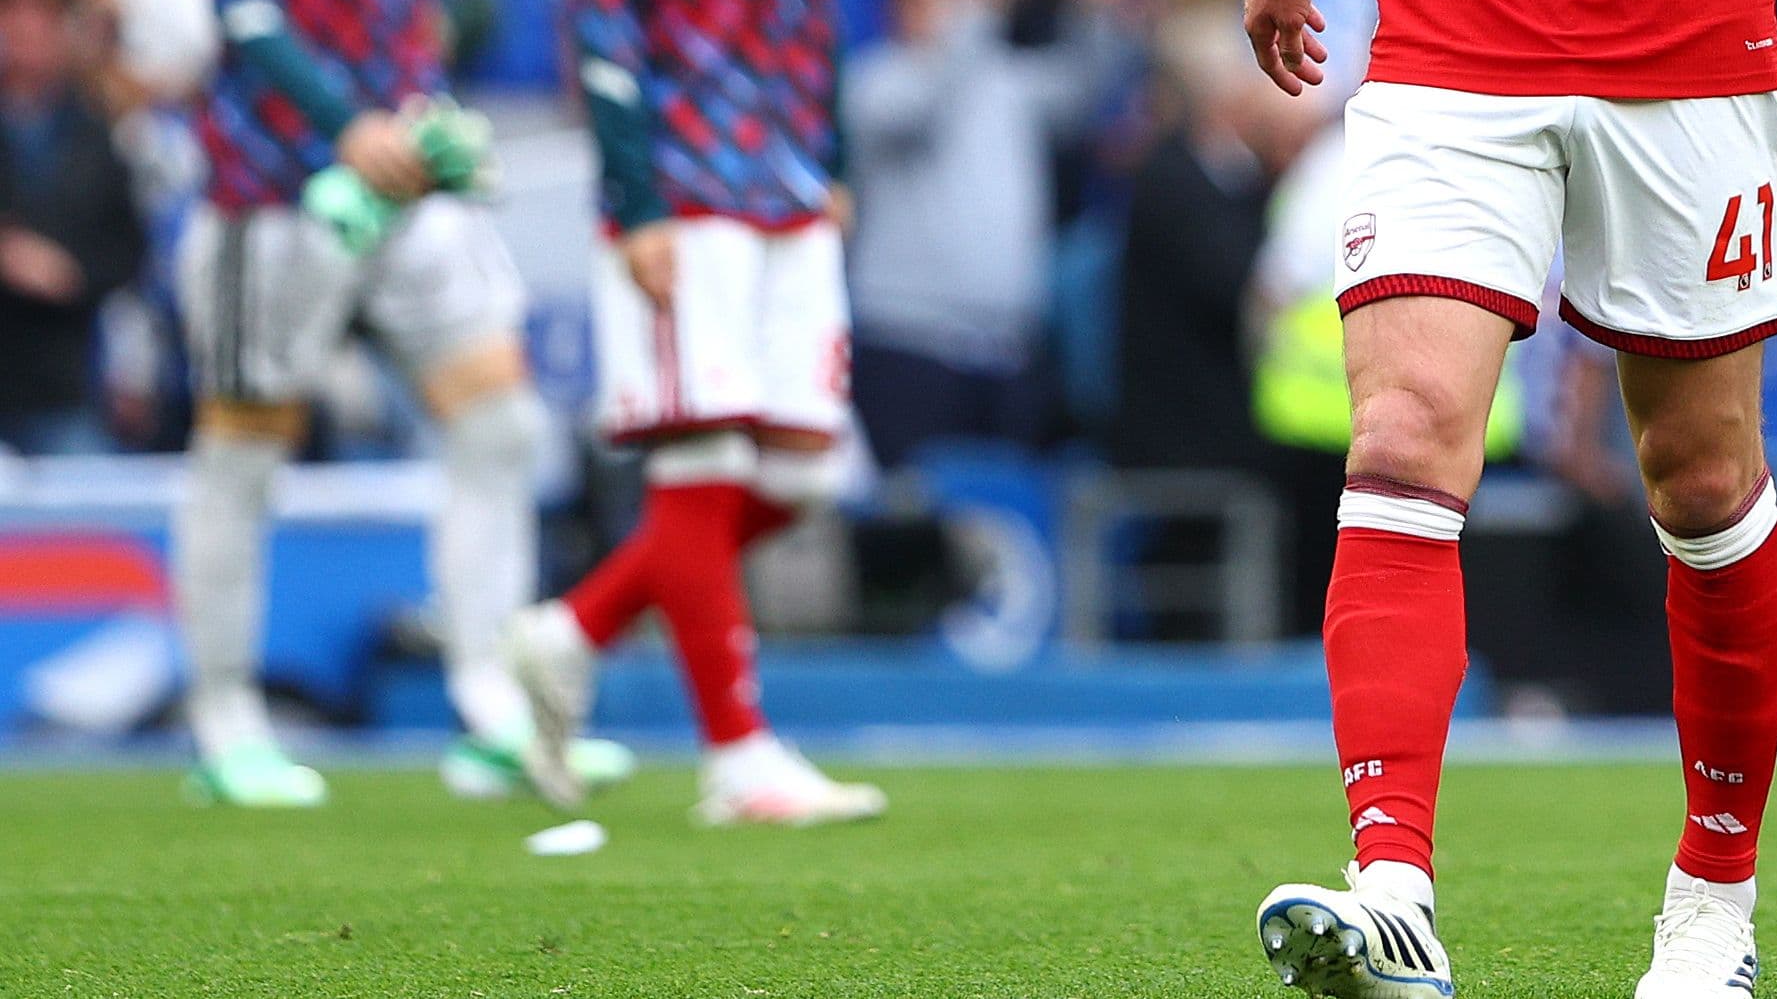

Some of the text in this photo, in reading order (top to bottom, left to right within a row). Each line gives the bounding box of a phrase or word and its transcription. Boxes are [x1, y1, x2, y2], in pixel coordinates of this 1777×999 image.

[1705, 181, 1774, 292] 41
[1344, 759, 1383, 788] AFC
[1694, 760, 1743, 783] AFC
